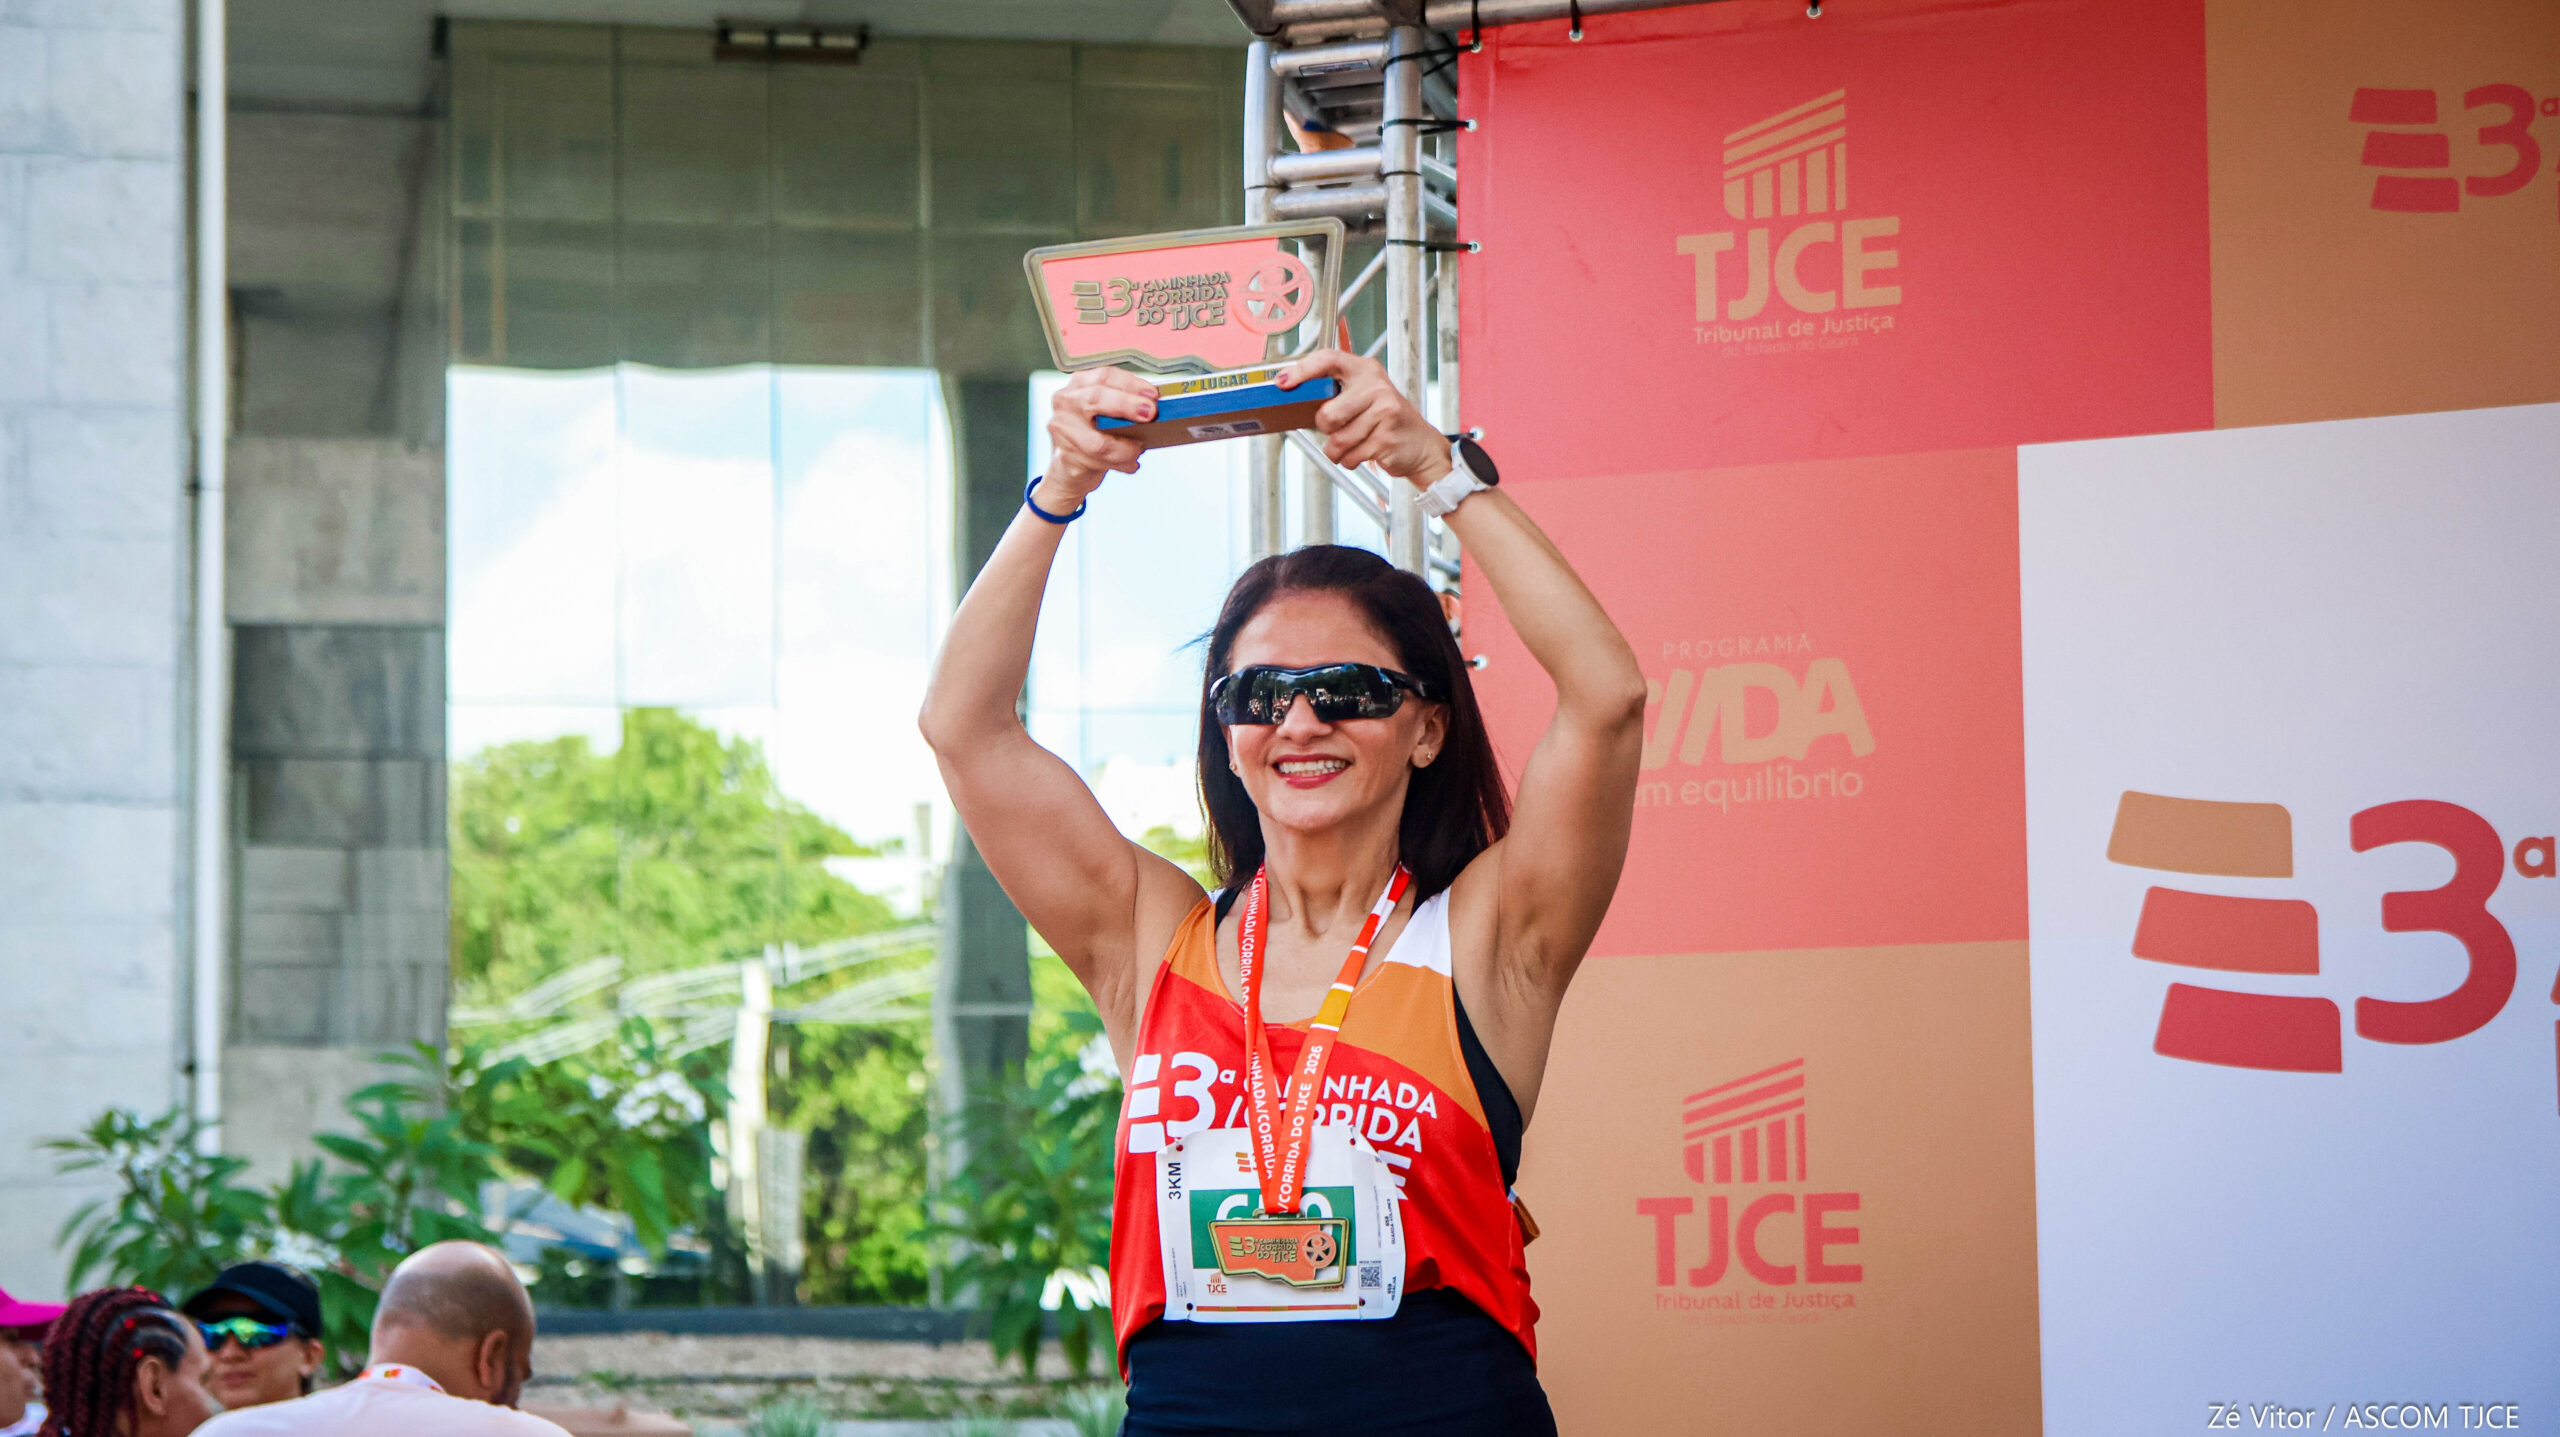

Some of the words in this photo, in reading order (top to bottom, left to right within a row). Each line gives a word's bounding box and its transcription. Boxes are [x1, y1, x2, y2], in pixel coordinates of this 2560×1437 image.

[1142, 271, 1231, 292] CAMINHADA
[1676, 215, 1902, 322] TJCE
[1137, 284, 1229, 309] /CORRIDA
[1136, 306, 1165, 326] DO
[1165, 300, 1226, 330] TJCE
[1693, 320, 1781, 345] Tribunal
[1788, 319, 1815, 337] de
[1821, 312, 1894, 334] Justiça
[1201, 373, 1249, 390] LUGAR
[1662, 633, 1813, 660] PROGRAMA
[1680, 764, 1863, 814] equilíbrio
[2349, 799, 2557, 1046] 3ª
[1304, 1045, 1324, 1076] 2026
[1166, 1051, 1237, 1139] 3ª
[1295, 1083, 1313, 1113] TJCE
[1290, 1115, 1305, 1138] DO
[1168, 1162, 1182, 1200] 3KM
[1636, 1192, 1863, 1288] TJCE
[1271, 1250, 1298, 1263] TJCE
[1207, 1283, 1228, 1294] TJCE
[1655, 1291, 1741, 1310] Tribunal
[1749, 1291, 1775, 1309] de
[1782, 1291, 1856, 1311] Justiça
